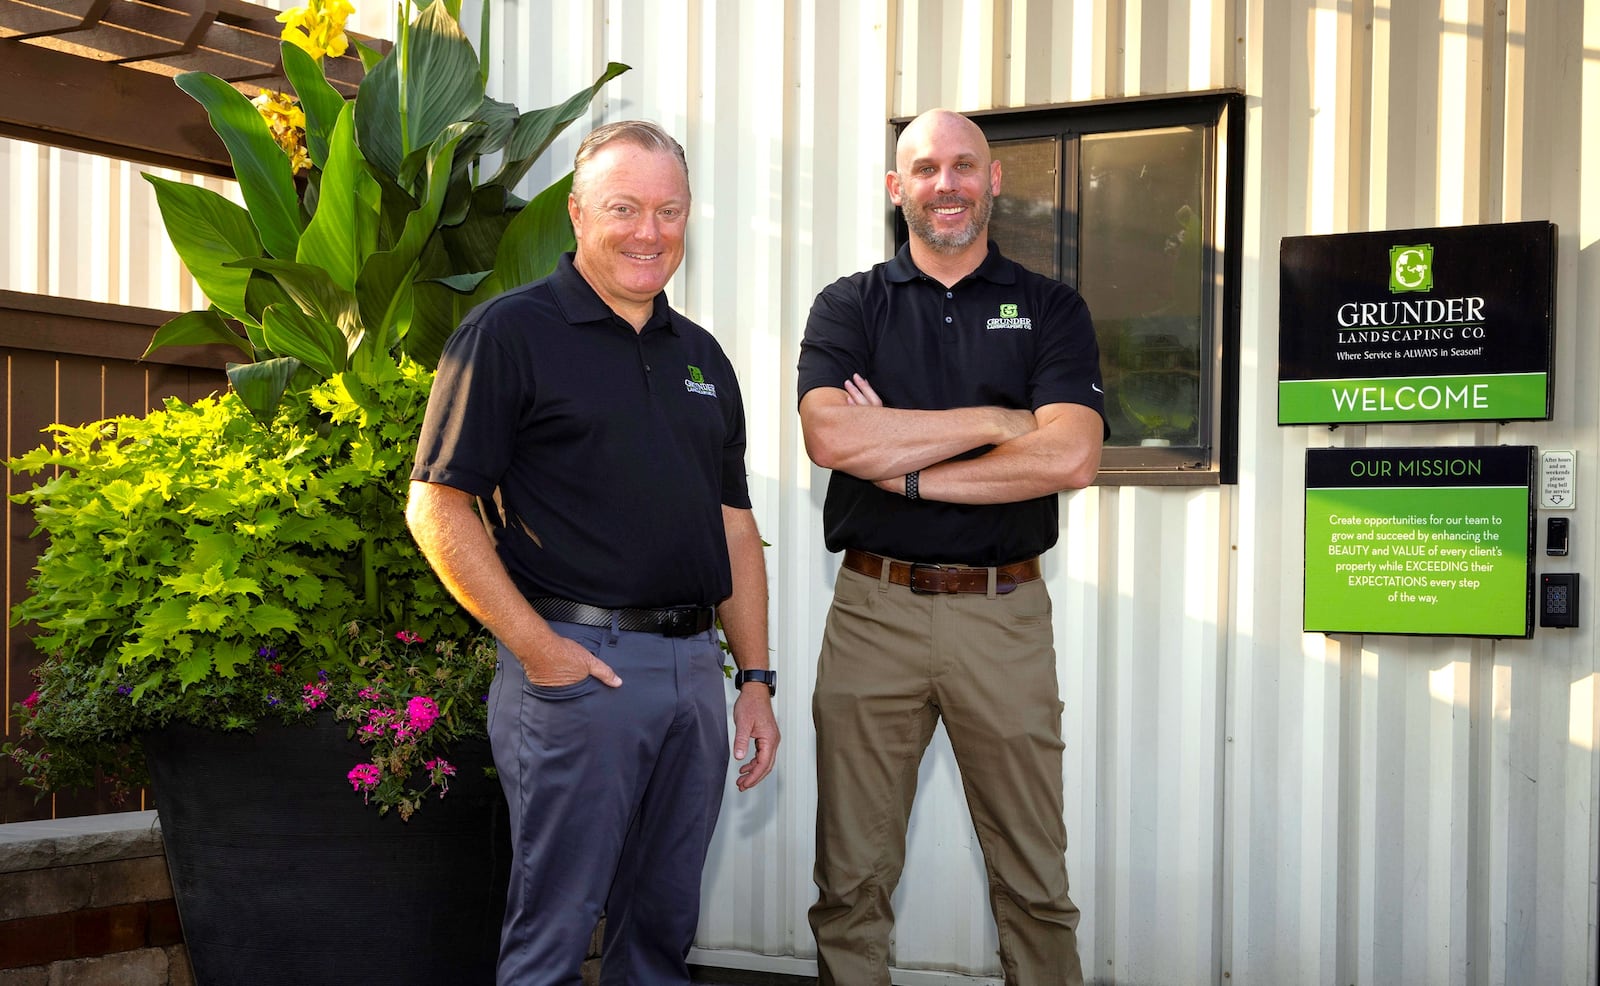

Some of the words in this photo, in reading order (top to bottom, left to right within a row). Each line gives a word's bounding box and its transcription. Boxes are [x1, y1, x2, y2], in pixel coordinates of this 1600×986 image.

[1337, 297, 1485, 327] GRUNDER
[987, 317, 1032, 325] GRUNDER
[1338, 328, 1454, 343] LANDSCAPING
[1462, 327, 1485, 338] CO.
[1337, 351, 1361, 360] Where
[1364, 350, 1392, 359] Service
[1395, 350, 1401, 358] is
[1403, 349, 1438, 358] ALWAYS
[1451, 347, 1482, 356] Season!
[1332, 384, 1489, 411] WELCOME
[1350, 460, 1392, 477] OUR
[1399, 459, 1482, 476] MISSION
[1329, 515, 1362, 526] Create
[1364, 514, 1427, 528] opportunities
[1430, 514, 1443, 525] for
[1445, 517, 1462, 525] our
[1464, 516, 1489, 525] team
[1492, 516, 1502, 525] to
[1331, 532, 1354, 543] grow
[1356, 530, 1374, 541] and
[1376, 530, 1415, 541] succeed
[1417, 530, 1429, 542] by
[1431, 530, 1480, 543] enhancing
[1483, 530, 1499, 541] the
[1329, 545, 1368, 556] BEAUTY
[1371, 545, 1389, 556] and
[1392, 546, 1425, 556] VALUE
[1428, 545, 1438, 556] of
[1440, 548, 1467, 559] every
[1469, 546, 1503, 557] client's
[1336, 562, 1376, 575] property
[1379, 561, 1403, 571] while
[1406, 561, 1468, 572] EXCEEDING
[1471, 561, 1493, 572] their
[1349, 576, 1427, 587] EXPECTATIONS
[1430, 578, 1457, 590] every
[1459, 578, 1480, 590] step
[1388, 591, 1398, 602] of
[1400, 592, 1416, 602] the
[1418, 594, 1438, 604] way.
